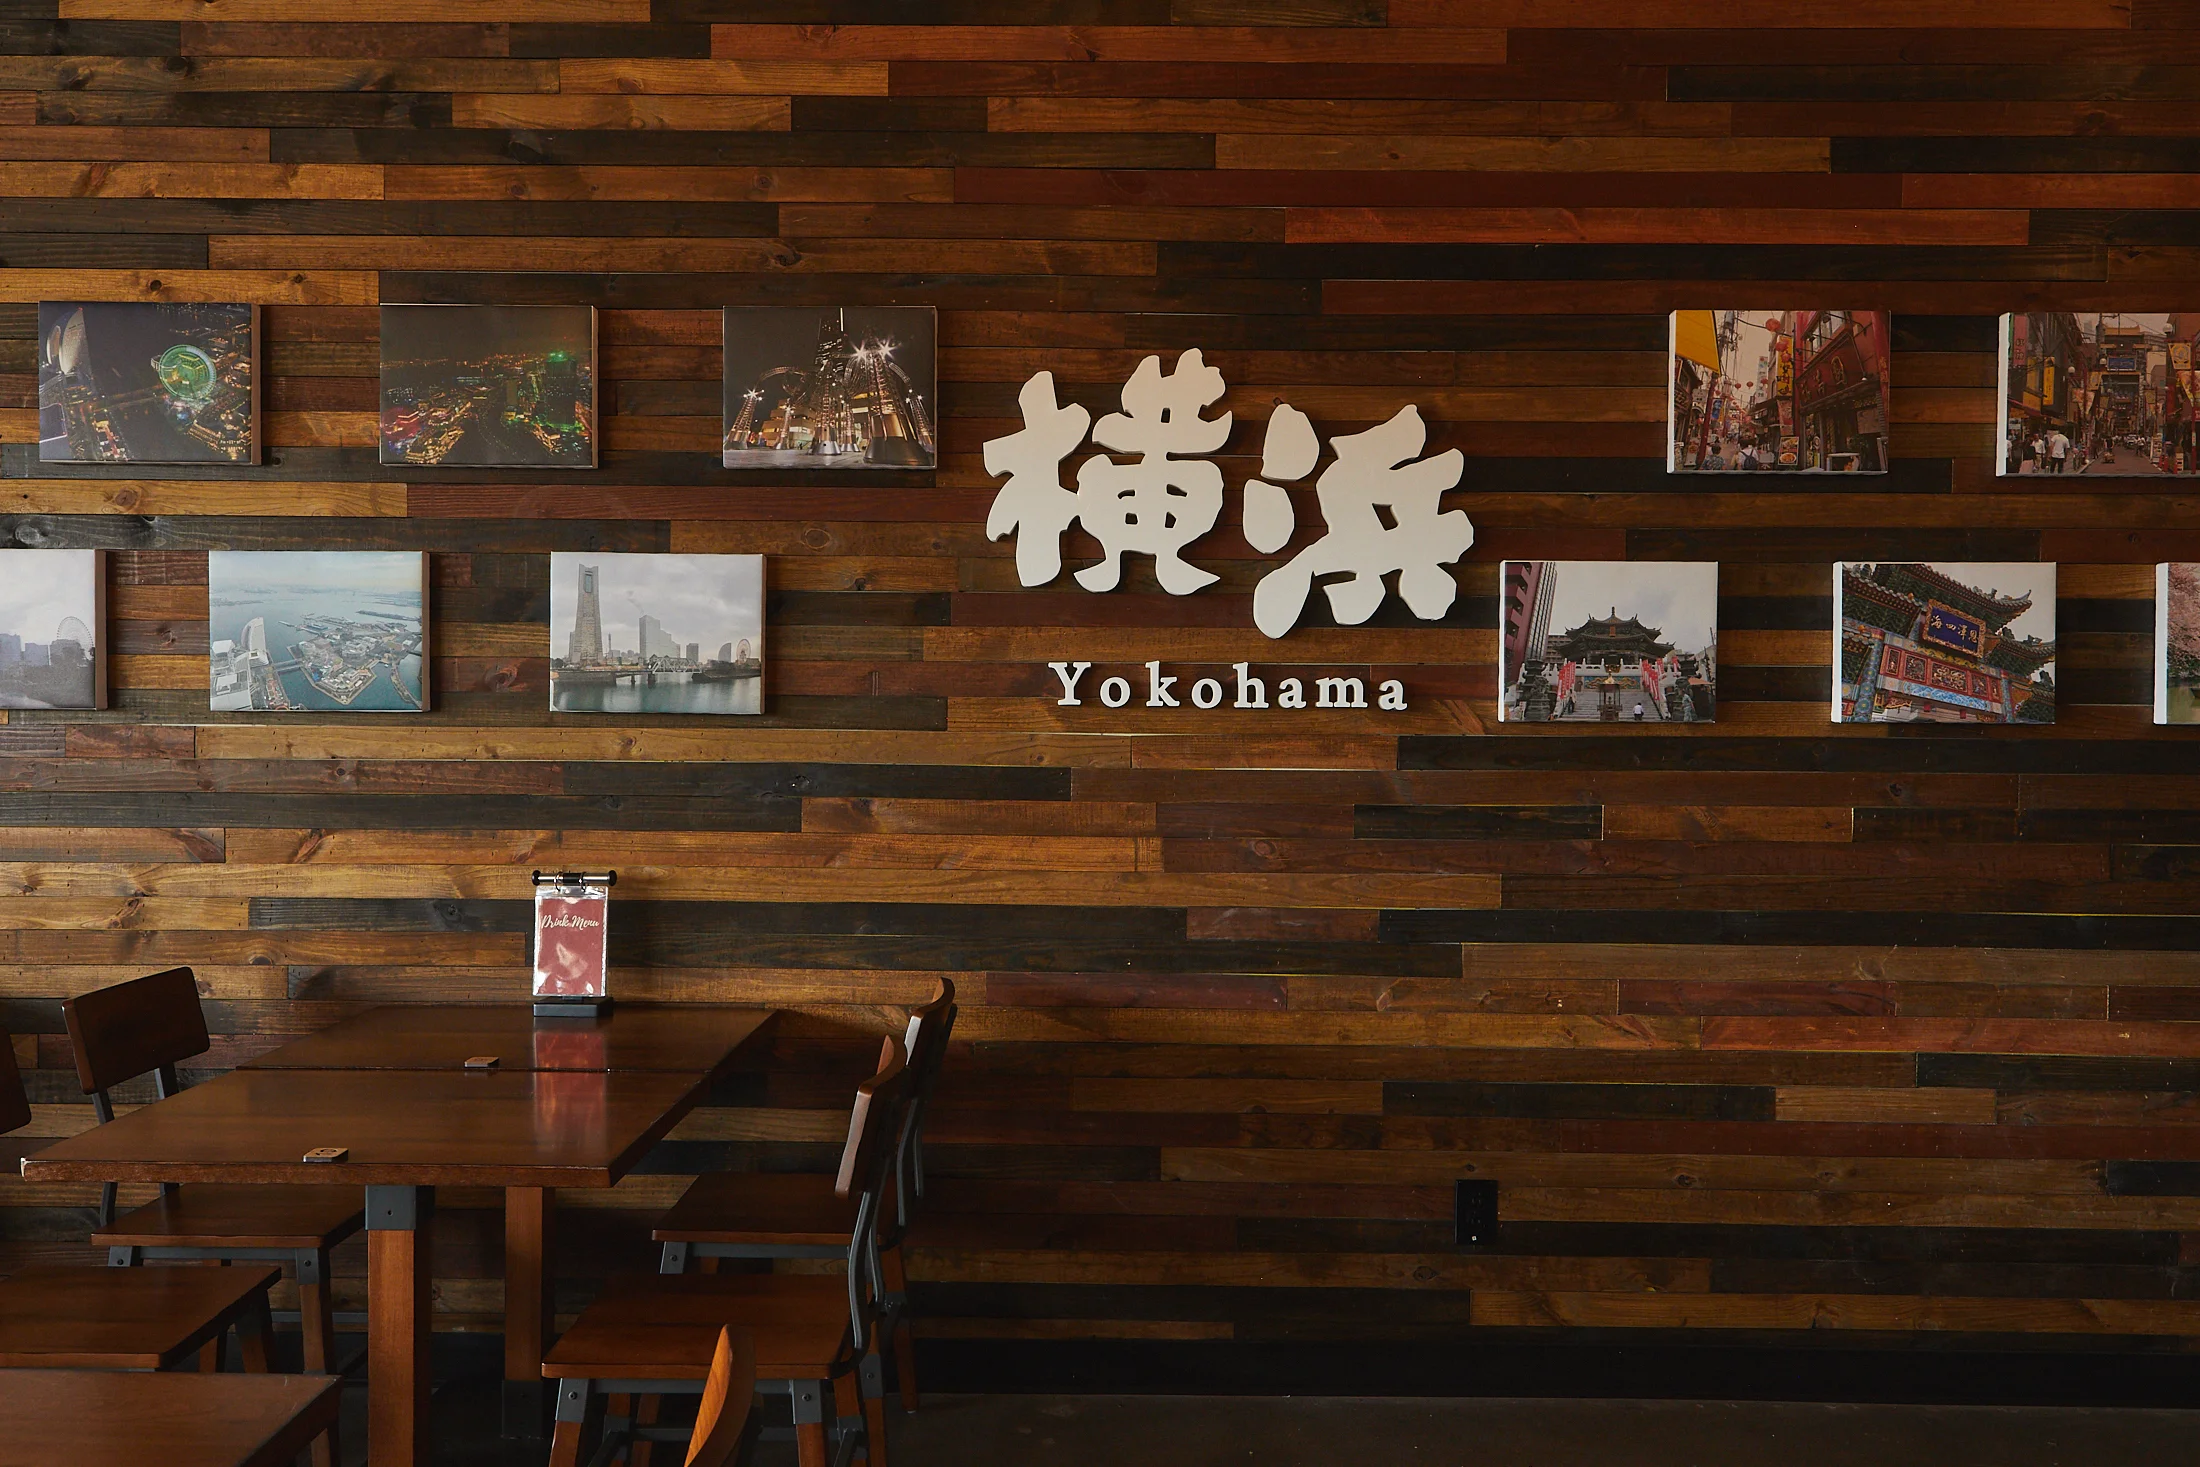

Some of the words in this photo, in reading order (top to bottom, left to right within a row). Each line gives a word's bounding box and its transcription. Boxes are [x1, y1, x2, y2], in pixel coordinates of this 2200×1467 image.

[983, 347, 1474, 639] 横浜
[1048, 660, 1408, 711] Yokohama
[541, 914, 569, 928] Drink
[571, 914, 599, 930] Menu
